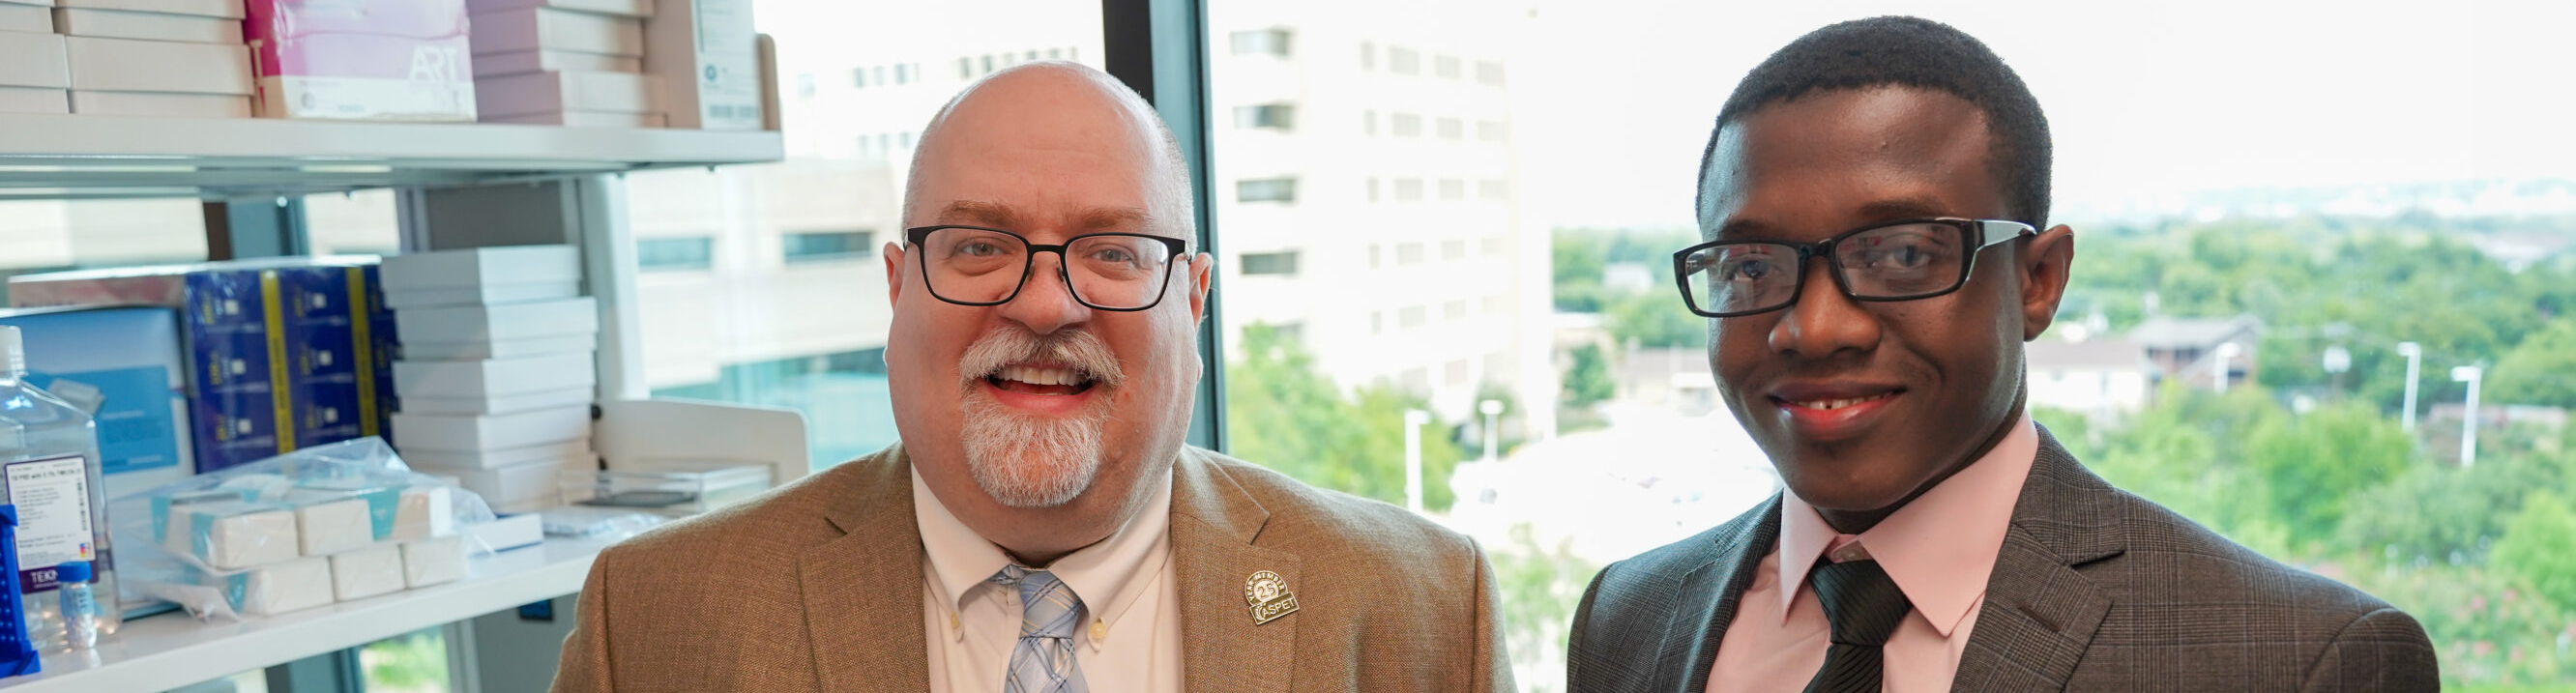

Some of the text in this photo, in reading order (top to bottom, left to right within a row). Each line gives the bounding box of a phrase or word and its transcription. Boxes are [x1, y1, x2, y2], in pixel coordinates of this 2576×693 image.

[408, 44, 457, 83] ART
[1254, 572, 1285, 591] MEMBER
[1257, 583, 1275, 598] 25
[1262, 597, 1295, 618] ASPET
